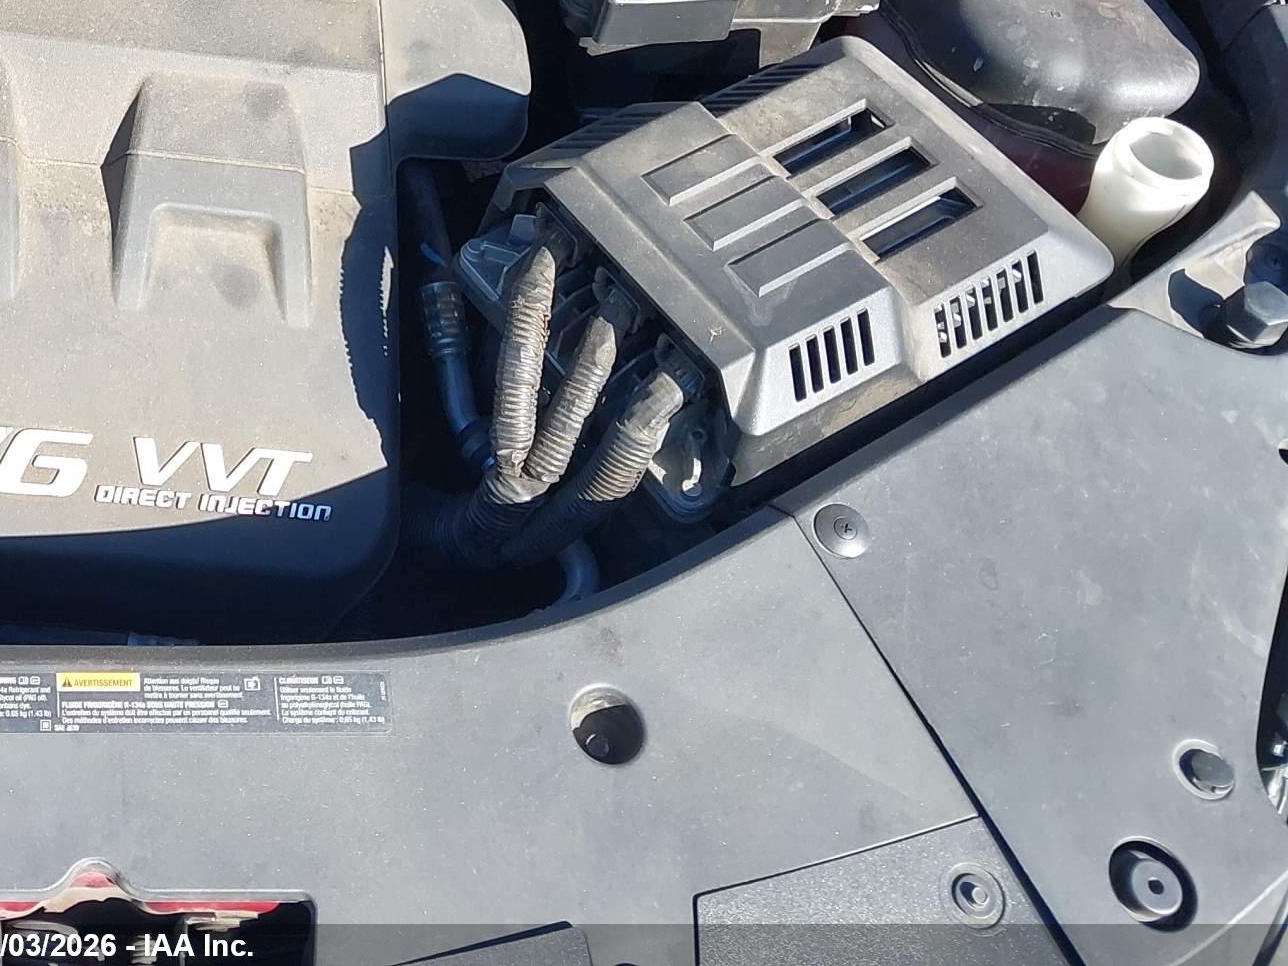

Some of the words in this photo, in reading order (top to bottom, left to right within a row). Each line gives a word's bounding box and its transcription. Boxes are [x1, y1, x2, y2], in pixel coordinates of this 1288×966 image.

[133, 436, 312, 496] VVT
[94, 485, 192, 508] DIRECT
[198, 494, 331, 521] INJECTION
